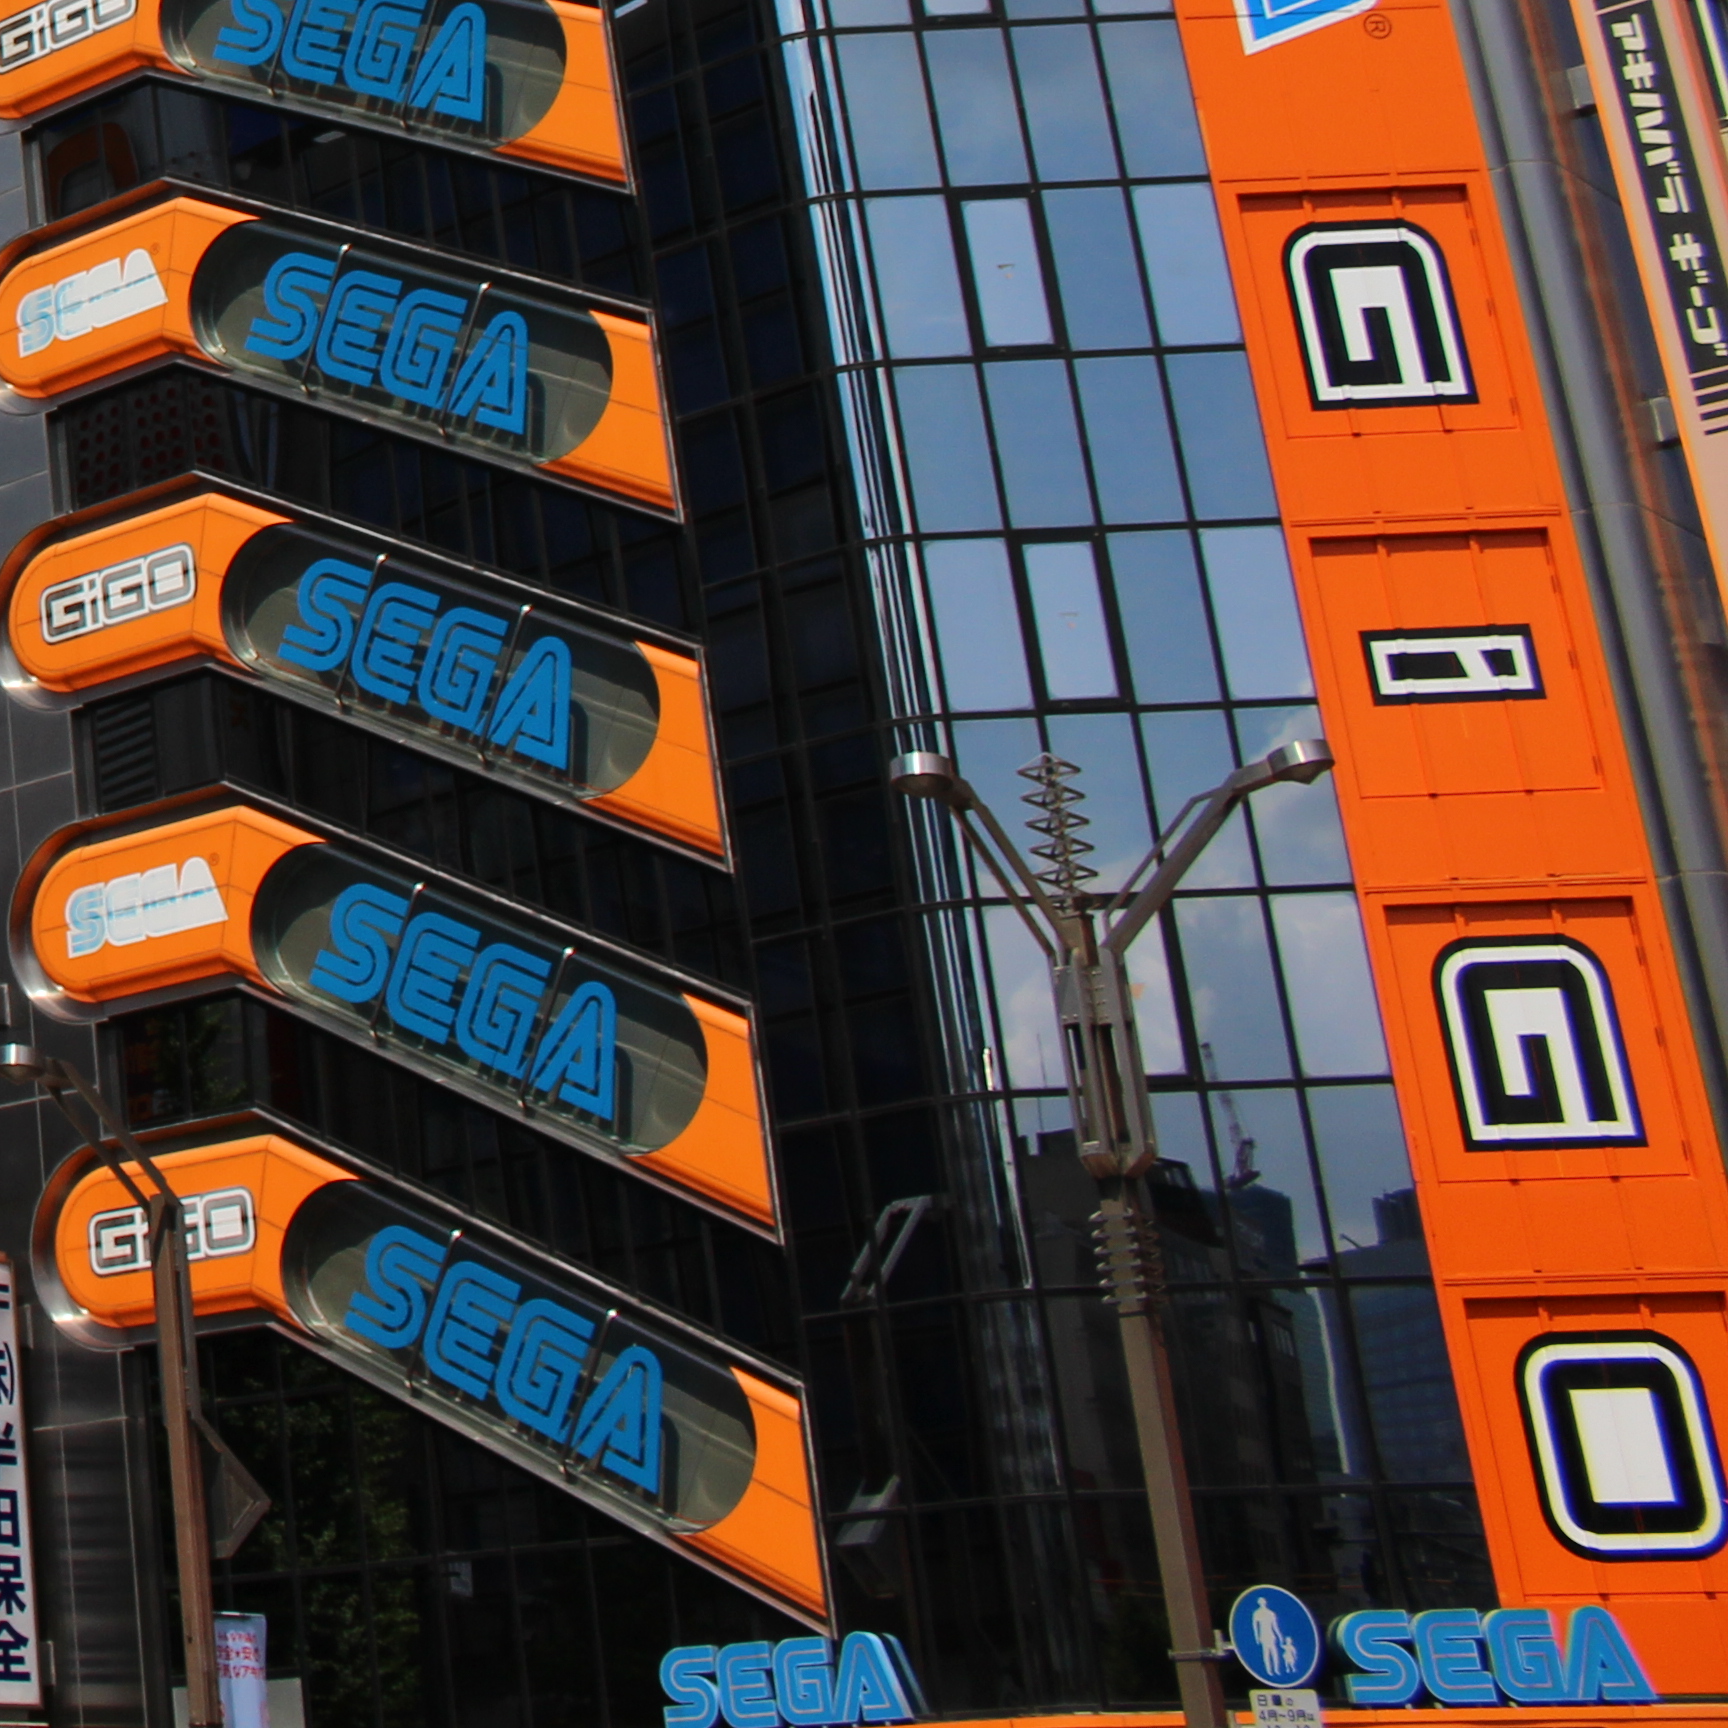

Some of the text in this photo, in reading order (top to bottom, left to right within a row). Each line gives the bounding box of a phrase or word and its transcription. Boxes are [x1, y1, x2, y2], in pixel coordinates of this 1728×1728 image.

[1610, 13, 1691, 214] アキハバラ
[245, 251, 528, 436] SEGA
[278, 556, 572, 771] SEGA
[309, 881, 618, 1122] SEGA
[88, 1186, 258, 1277] GO
[344, 1223, 664, 1494] SEGA
[658, 1629, 916, 1728] SEGA
[1341, 1605, 1664, 1706] SEGA
